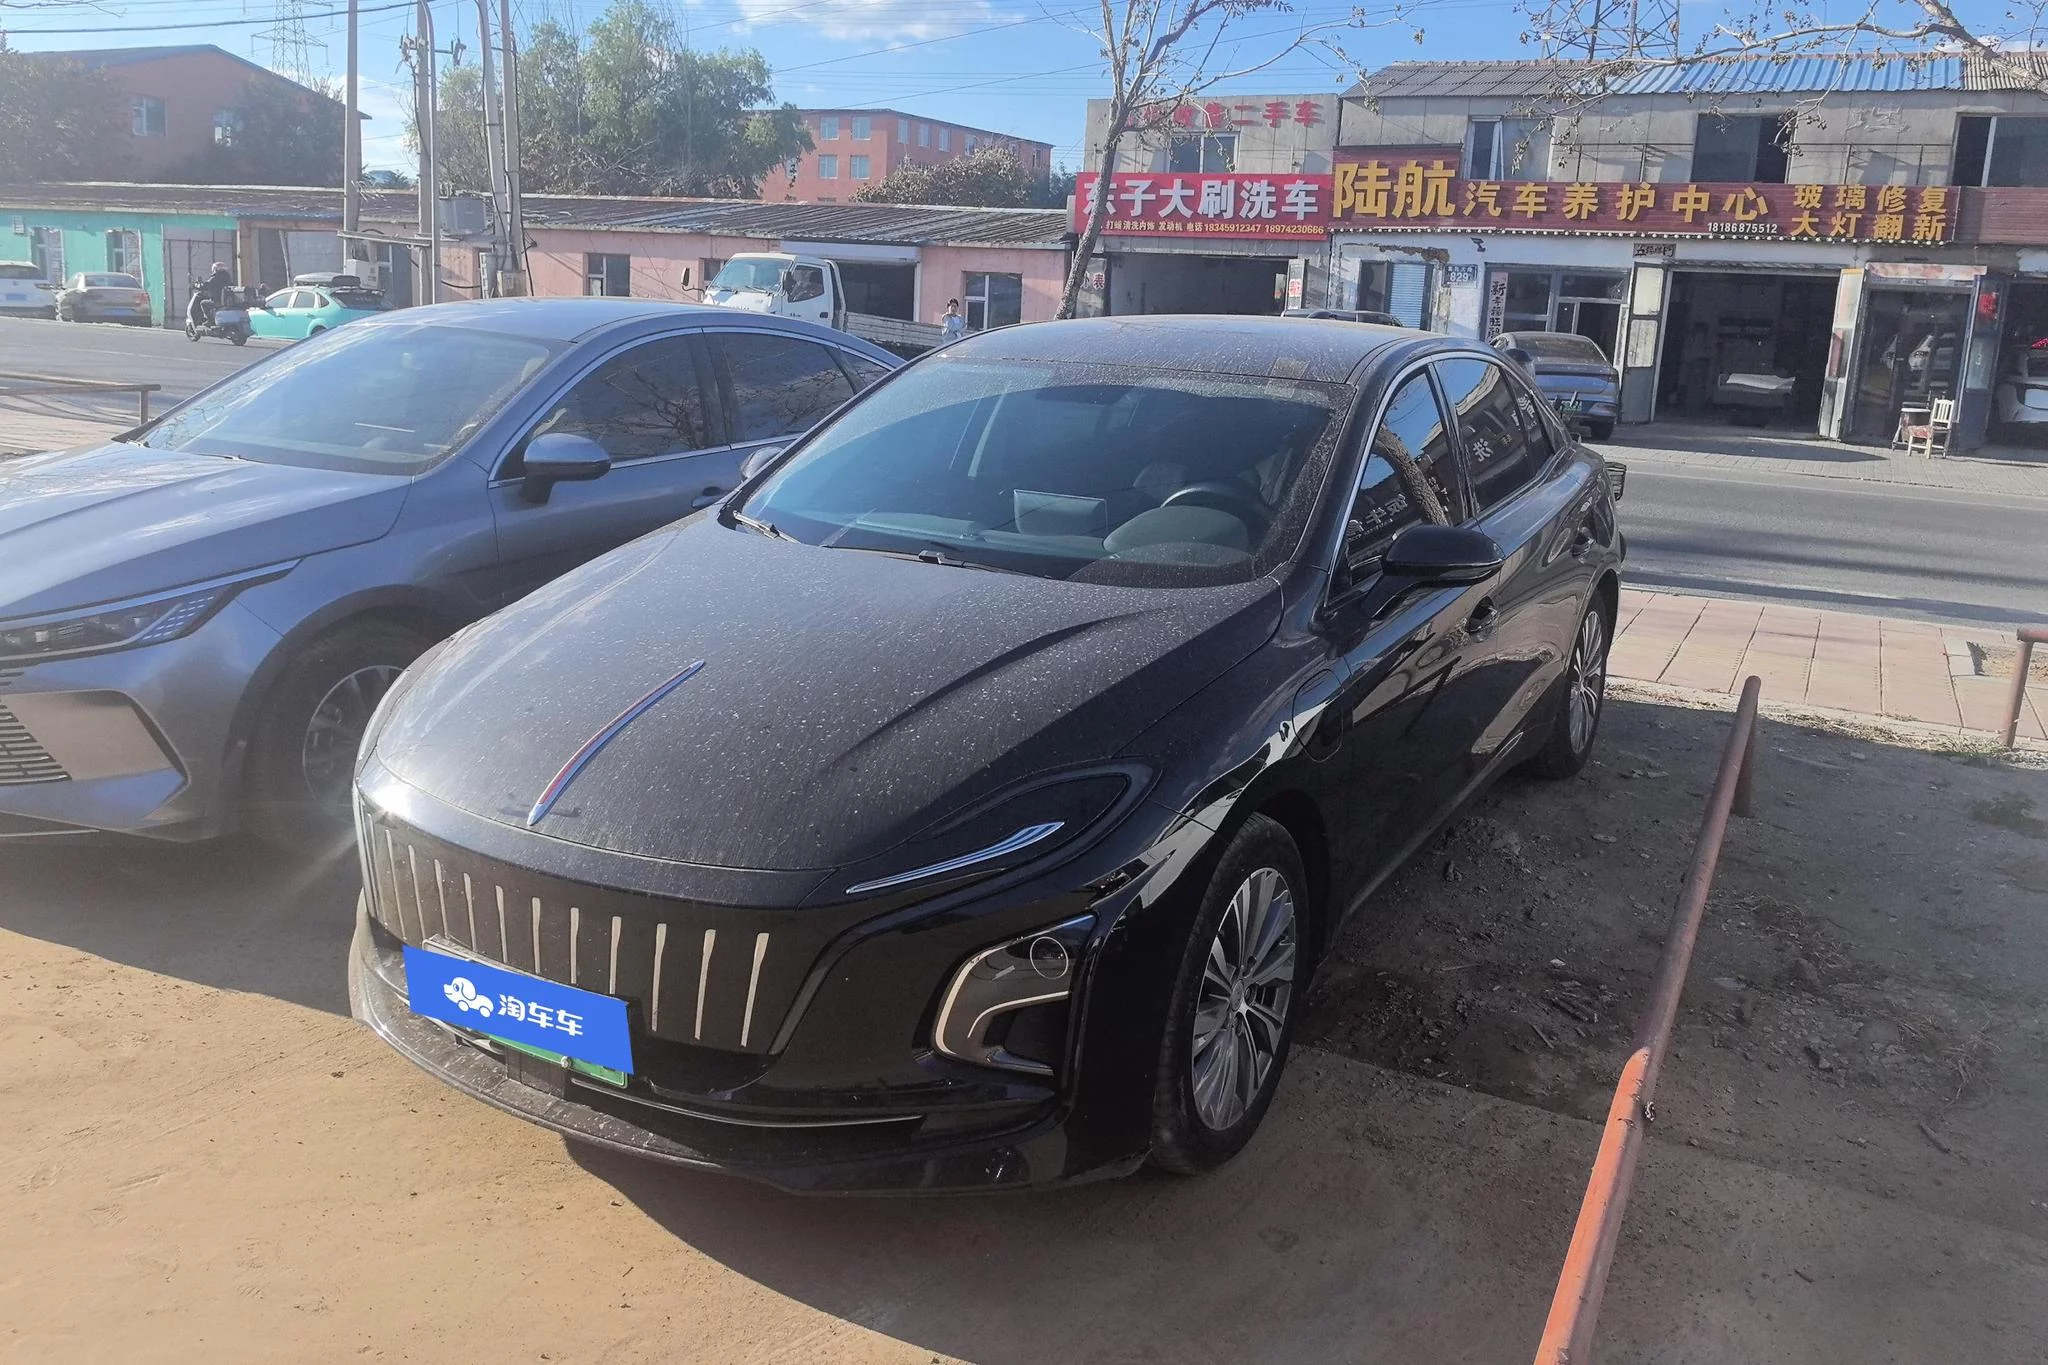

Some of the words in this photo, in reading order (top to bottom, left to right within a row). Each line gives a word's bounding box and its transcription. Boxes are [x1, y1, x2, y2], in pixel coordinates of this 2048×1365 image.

[1082, 178, 1319, 221] 东子大刷洗车
[1332, 160, 1456, 218] 陆航
[1462, 181, 1769, 223] 汽车养护中心
[1793, 183, 1948, 214] 玻璃修复
[1707, 222, 1778, 234] 18186875512
[1790, 211, 1946, 241] 大灯翻新
[1449, 271, 1469, 282] 829
